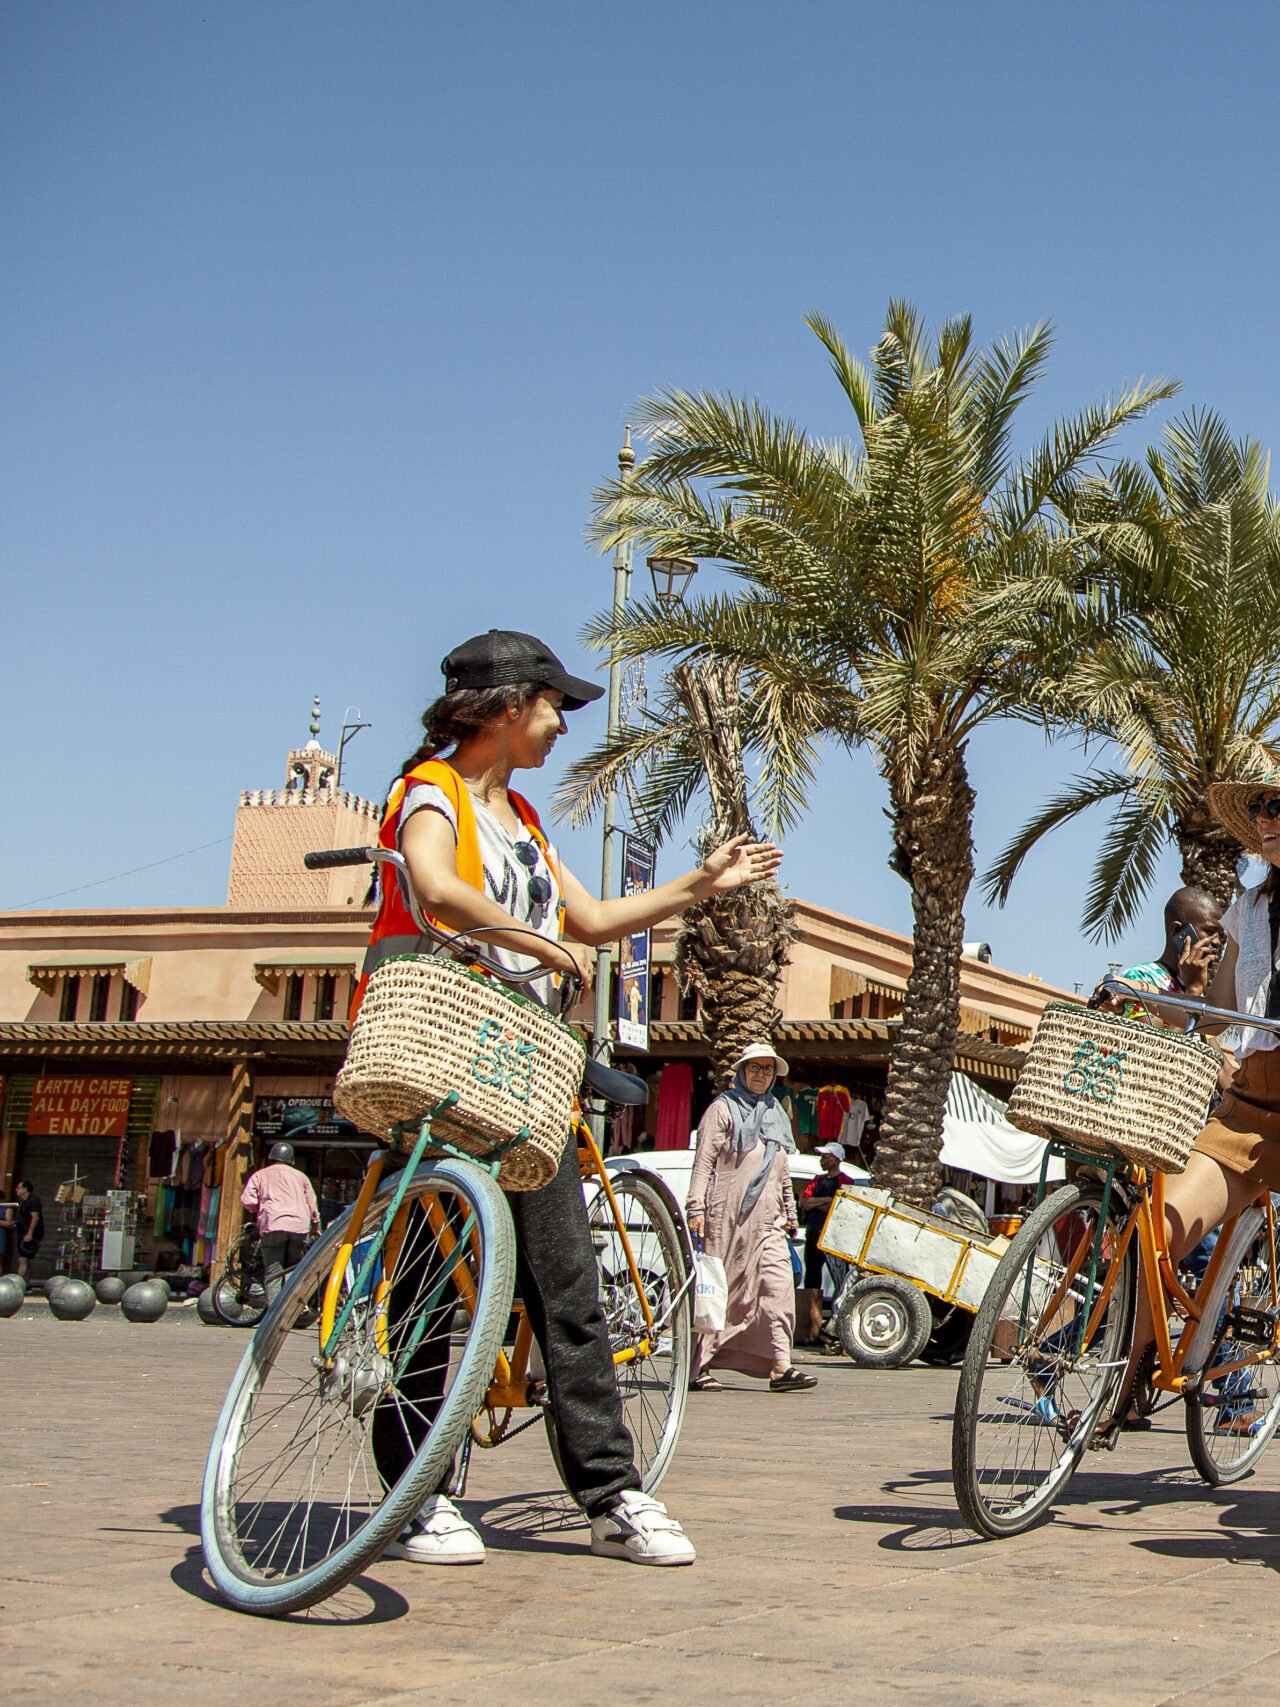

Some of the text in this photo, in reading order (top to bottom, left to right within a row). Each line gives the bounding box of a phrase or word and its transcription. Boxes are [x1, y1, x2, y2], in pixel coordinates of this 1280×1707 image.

[36, 1079, 130, 1095] EARTH CAFE
[35, 1097, 129, 1113] ALL DAY FOOD
[288, 1098, 322, 1107] OPTIQUE
[49, 1113, 117, 1135] ENJOY
